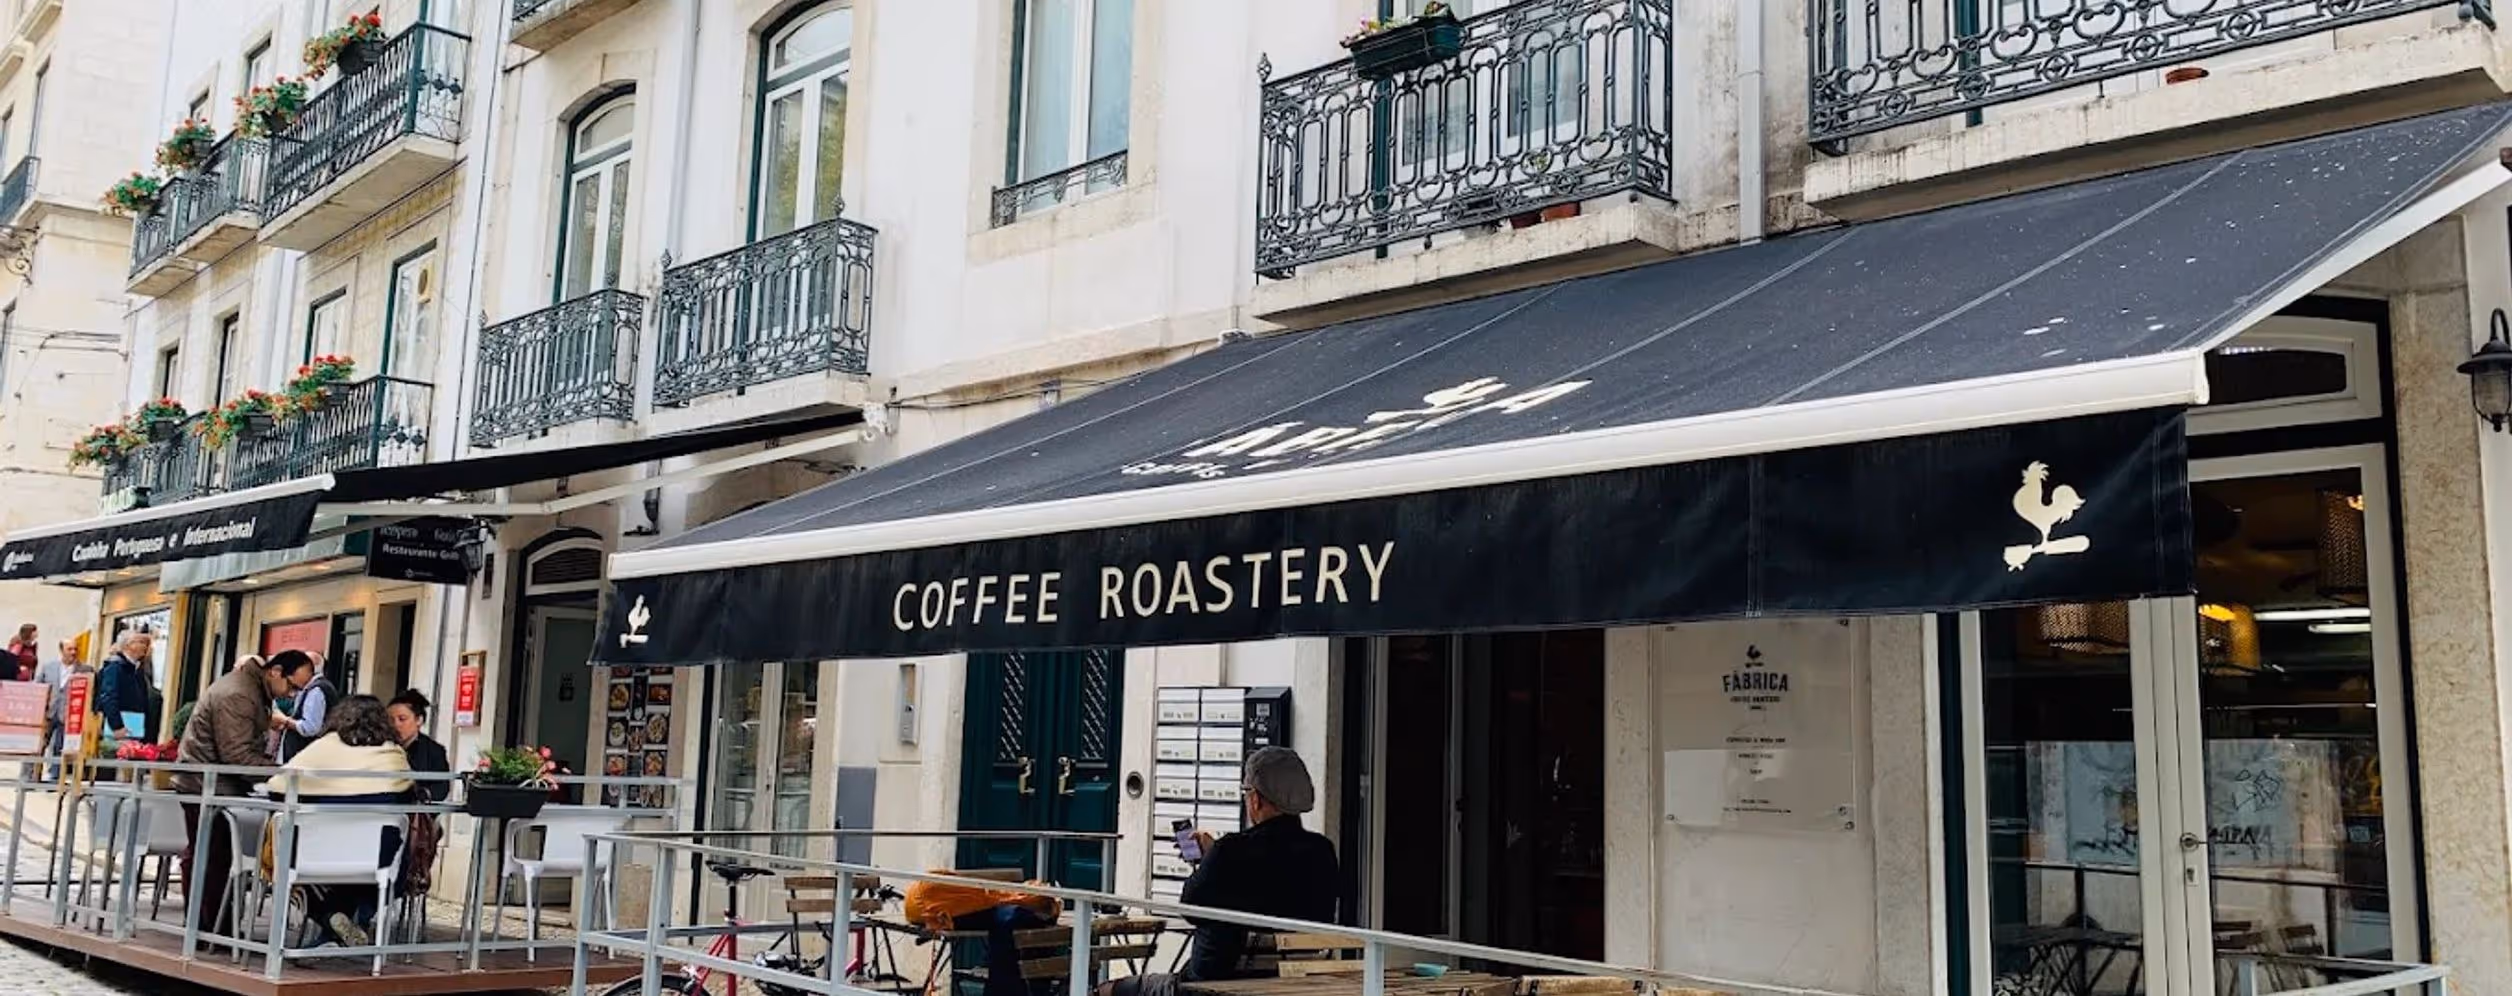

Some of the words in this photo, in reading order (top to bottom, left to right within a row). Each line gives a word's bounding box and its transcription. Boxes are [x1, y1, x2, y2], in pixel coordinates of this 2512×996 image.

[168, 532, 178, 548] e
[184, 517, 257, 546] Internacional
[893, 571, 1061, 631] COFFEE
[1100, 541, 1395, 619] ROASTERY
